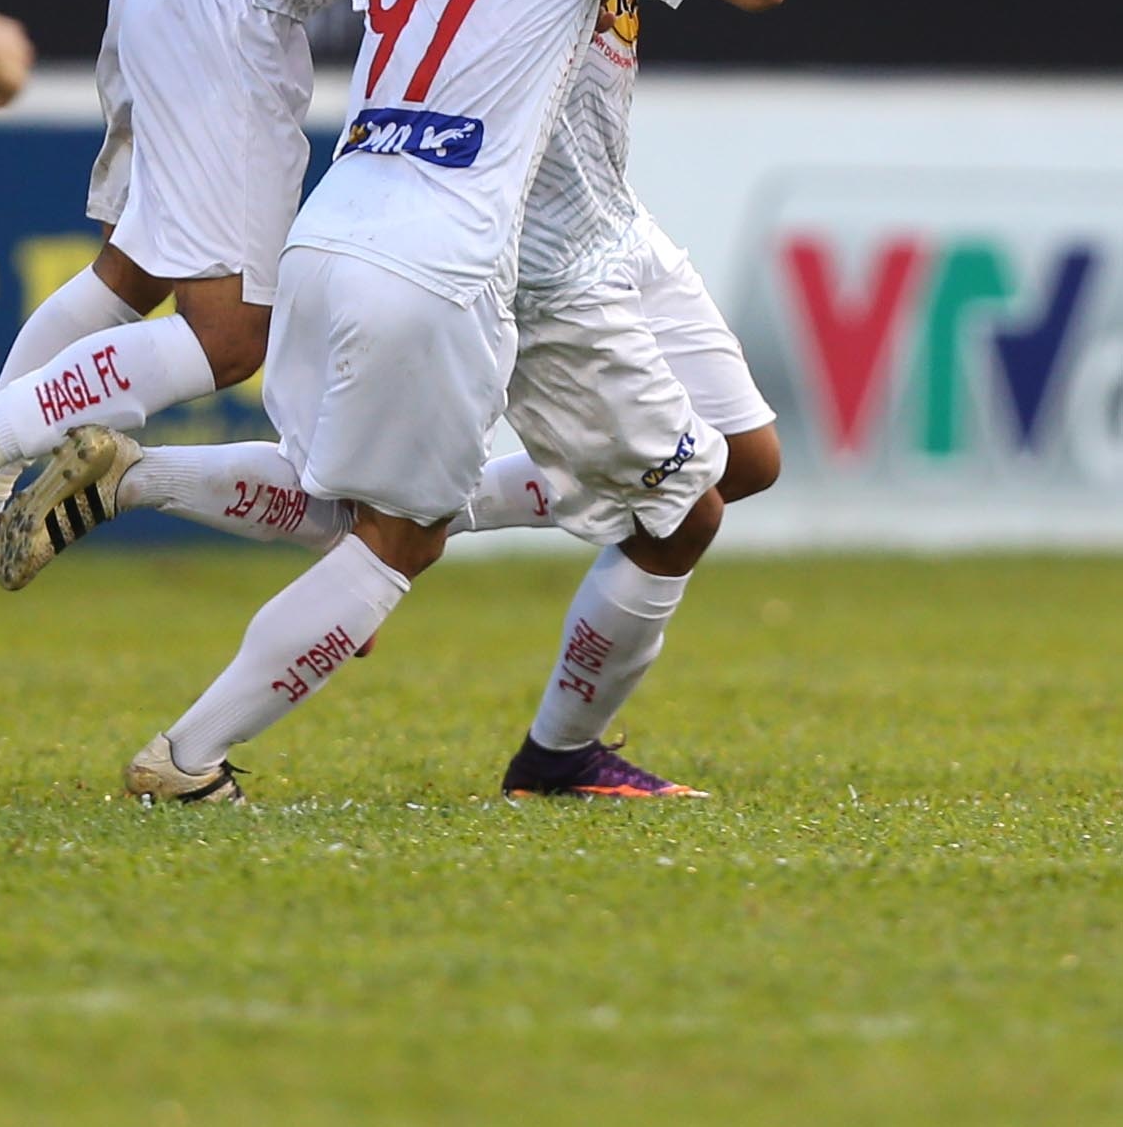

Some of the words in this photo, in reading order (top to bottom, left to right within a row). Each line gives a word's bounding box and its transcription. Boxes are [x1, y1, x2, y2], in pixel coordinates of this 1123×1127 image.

[34, 363, 101, 426] HAGL
[91, 344, 131, 398] FC
[224, 480, 264, 518] FC
[256, 484, 308, 533] HAGL
[296, 624, 356, 677] HAGL
[564, 617, 613, 675] HAGL
[271, 667, 310, 703] FC
[558, 664, 596, 703] FC
